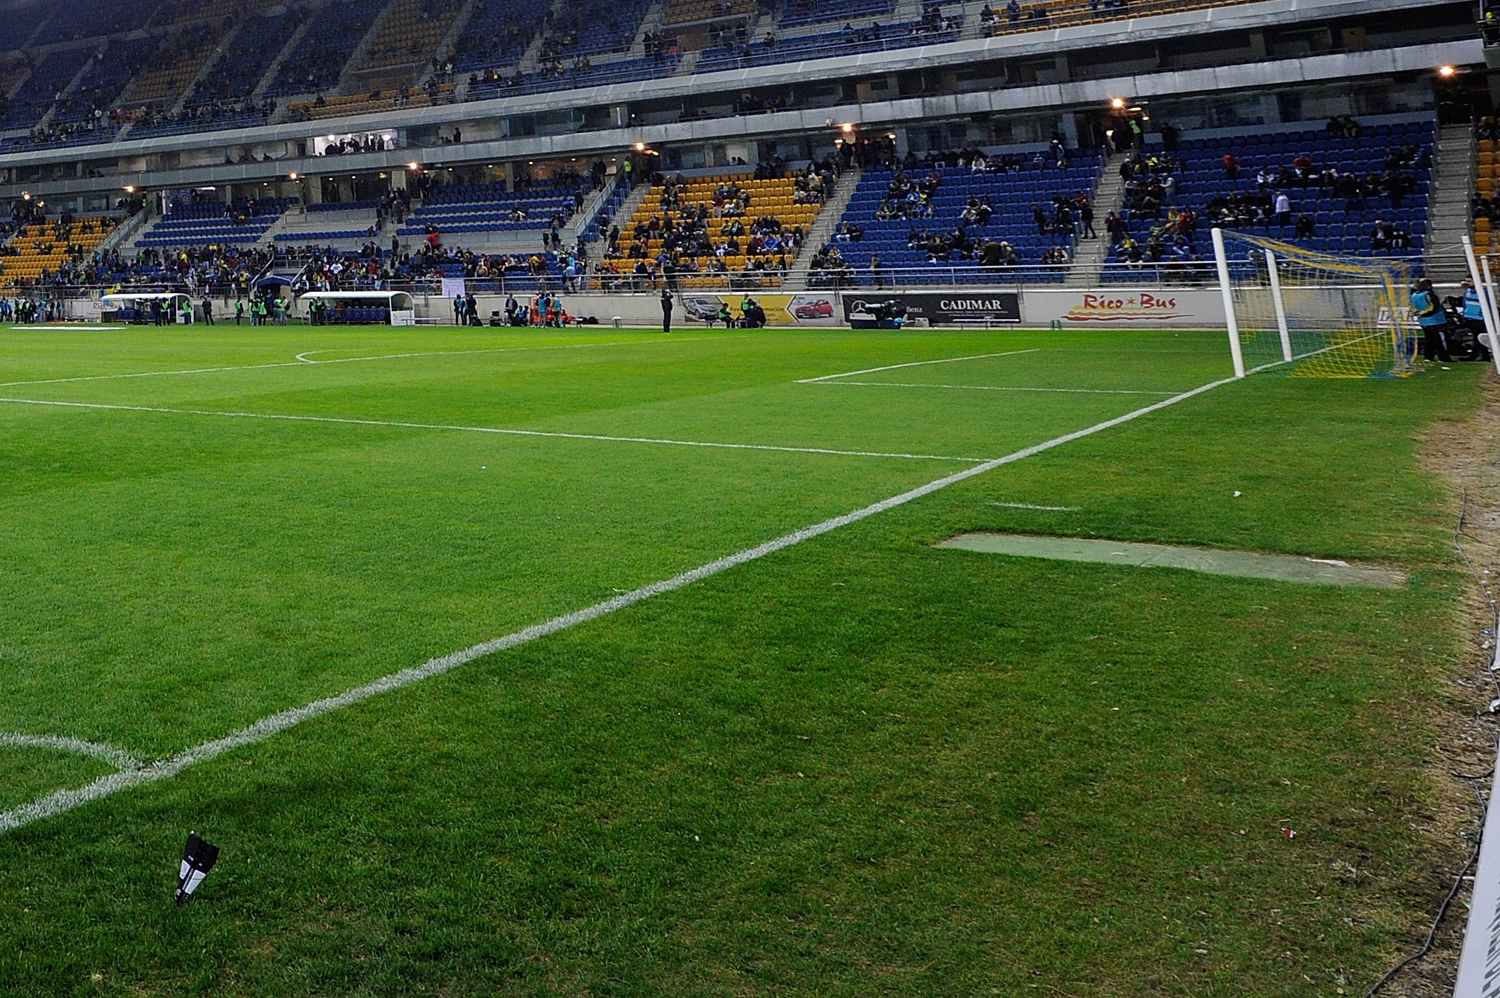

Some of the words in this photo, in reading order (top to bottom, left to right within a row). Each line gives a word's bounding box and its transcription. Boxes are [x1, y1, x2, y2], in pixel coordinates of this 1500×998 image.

[940, 299, 1002, 310] CADIMAR
[1083, 294, 1124, 309] Rico
[1140, 293, 1176, 309] Bus
